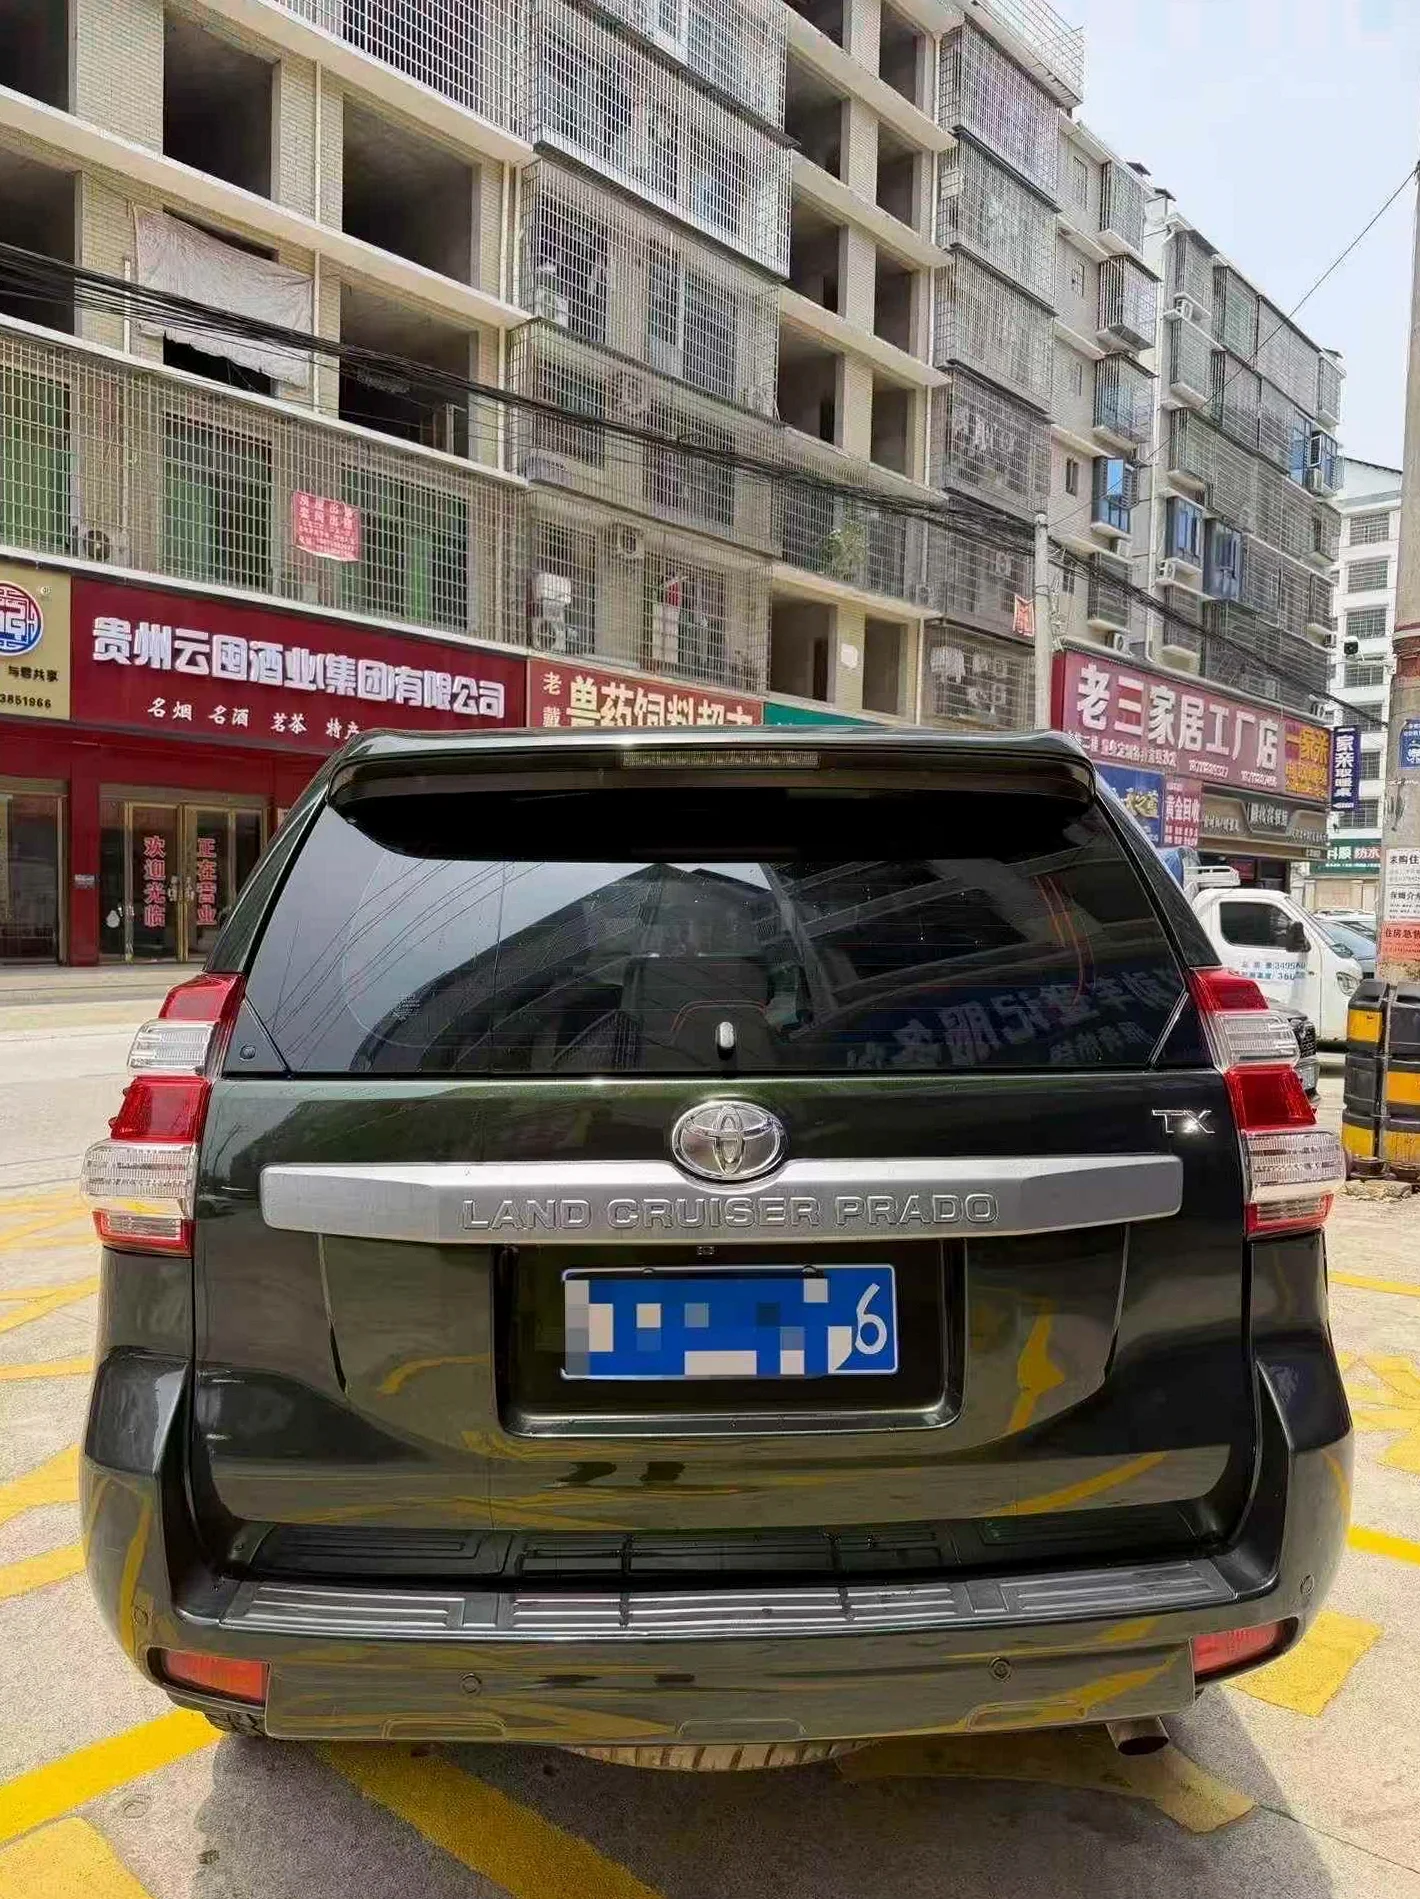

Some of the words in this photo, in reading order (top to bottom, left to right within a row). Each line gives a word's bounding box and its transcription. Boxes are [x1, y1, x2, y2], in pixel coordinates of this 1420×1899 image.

[147, 697, 193, 721] 名烟
[208, 704, 250, 727] 名酒
[270, 712, 308, 735] 茗茶
[1077, 663, 1279, 770] 老三家居工厂店
[143, 835, 167, 928] 欢迎光临
[196, 837, 218, 926] 正在营业
[1151, 1109, 1216, 1134] TX
[463, 1199, 592, 1231] LAND
[606, 1197, 820, 1229] CRUISER
[834, 1193, 999, 1227] PRADO
